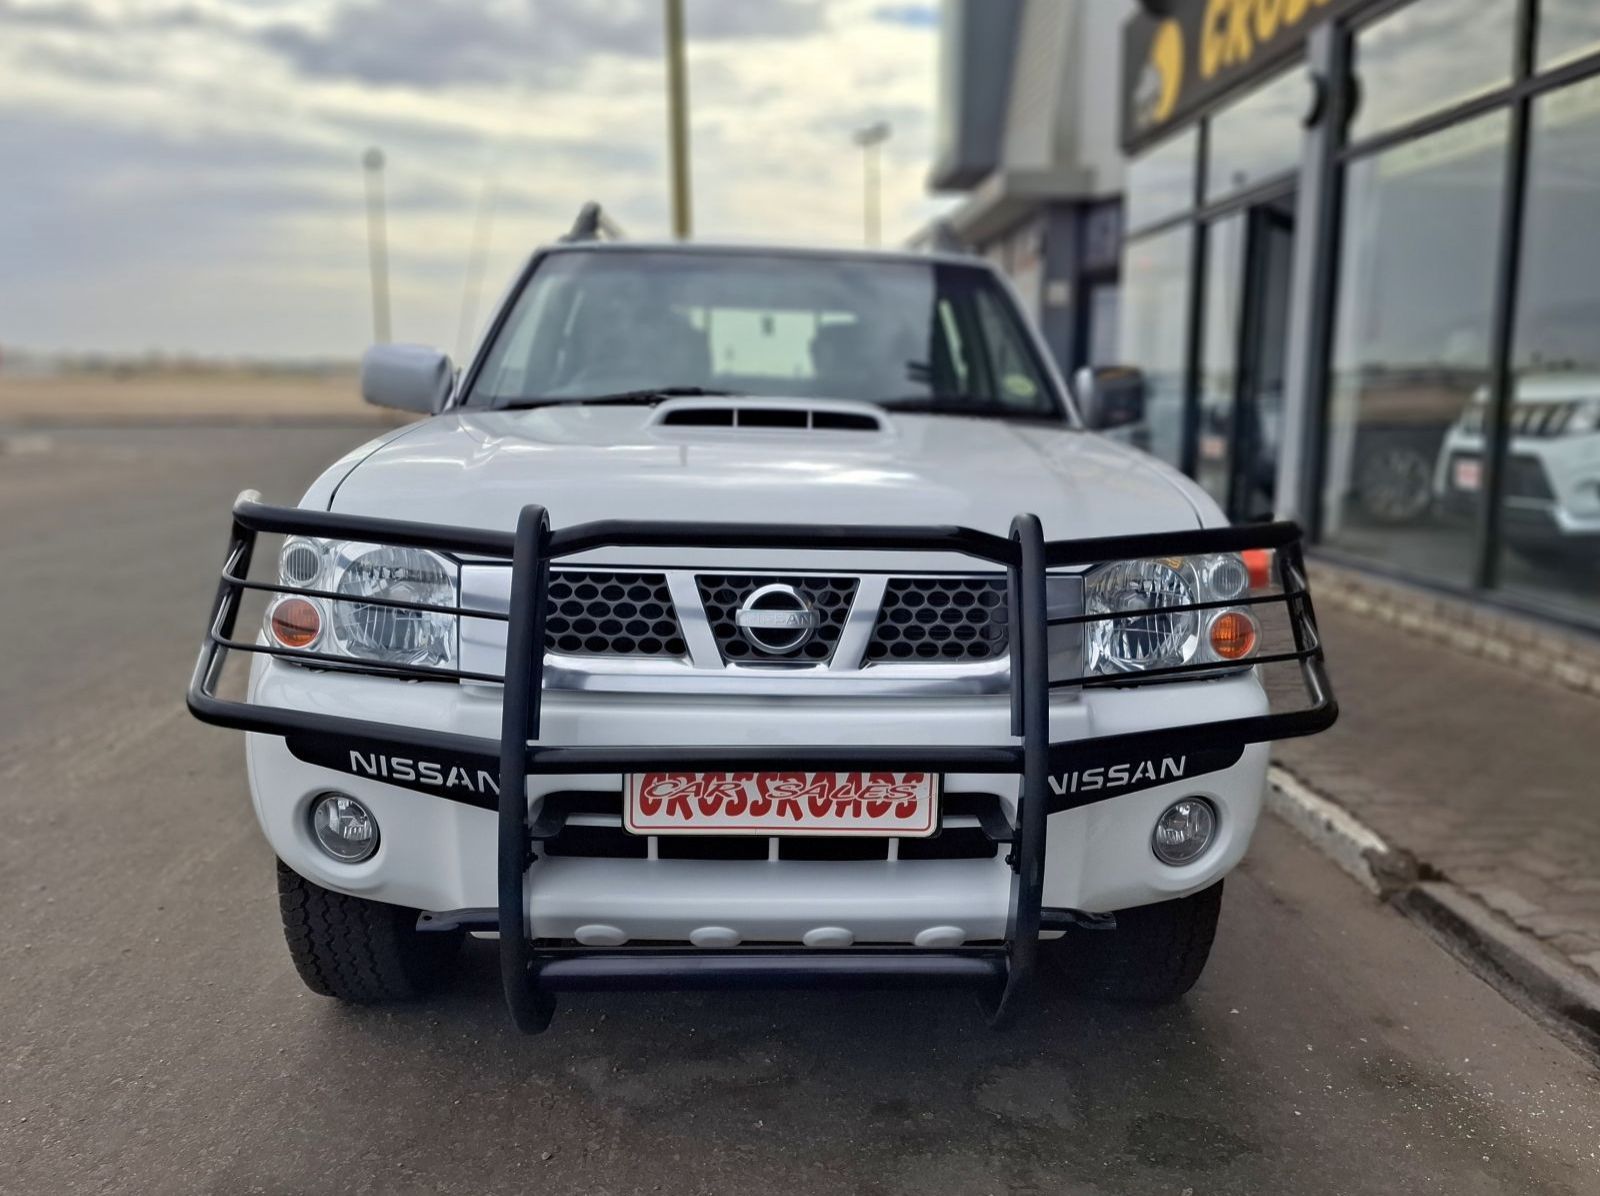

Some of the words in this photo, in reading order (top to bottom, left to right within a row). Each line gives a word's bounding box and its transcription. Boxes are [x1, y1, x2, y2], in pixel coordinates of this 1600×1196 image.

[746, 612, 812, 625] NISSAN
[349, 750, 500, 795] NISSAN
[639, 772, 924, 821] CROSSROADS
[645, 781, 742, 800] CAR
[766, 782, 920, 801] SALES
